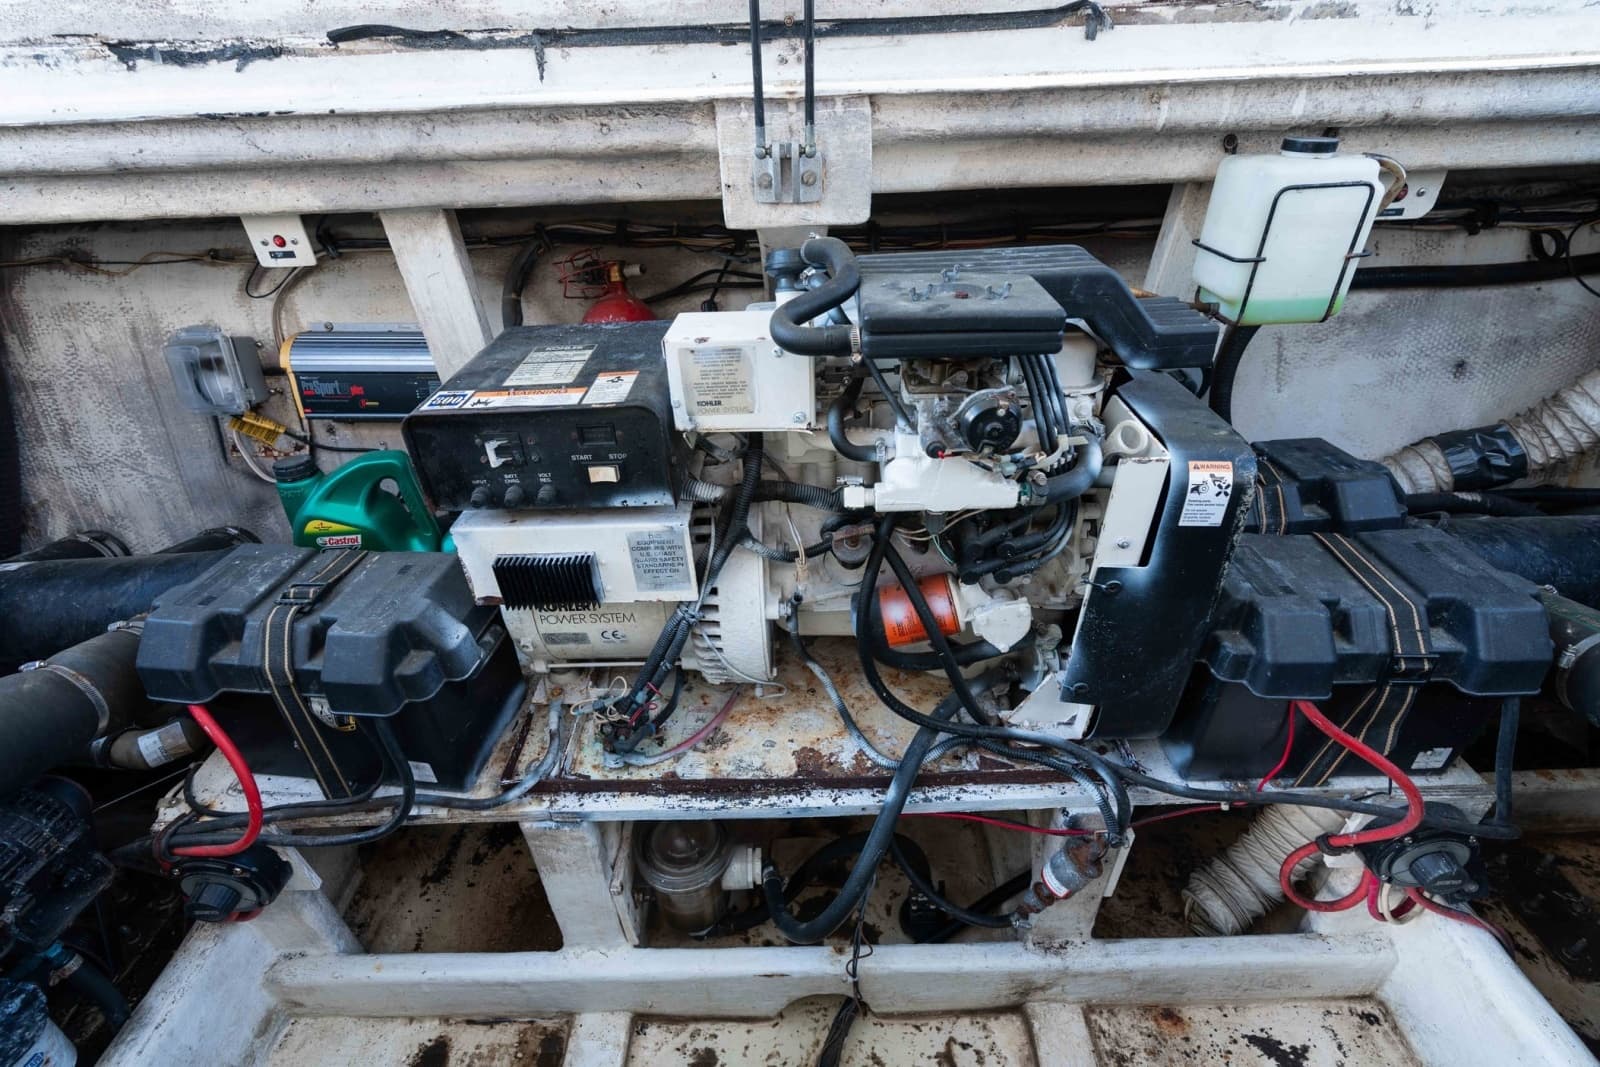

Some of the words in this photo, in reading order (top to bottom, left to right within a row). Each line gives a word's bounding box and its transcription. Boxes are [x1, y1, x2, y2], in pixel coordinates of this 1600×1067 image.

[327, 535, 359, 545] Castrol
[539, 613, 587, 624] POWER
[589, 612, 636, 624] SYSTEM
